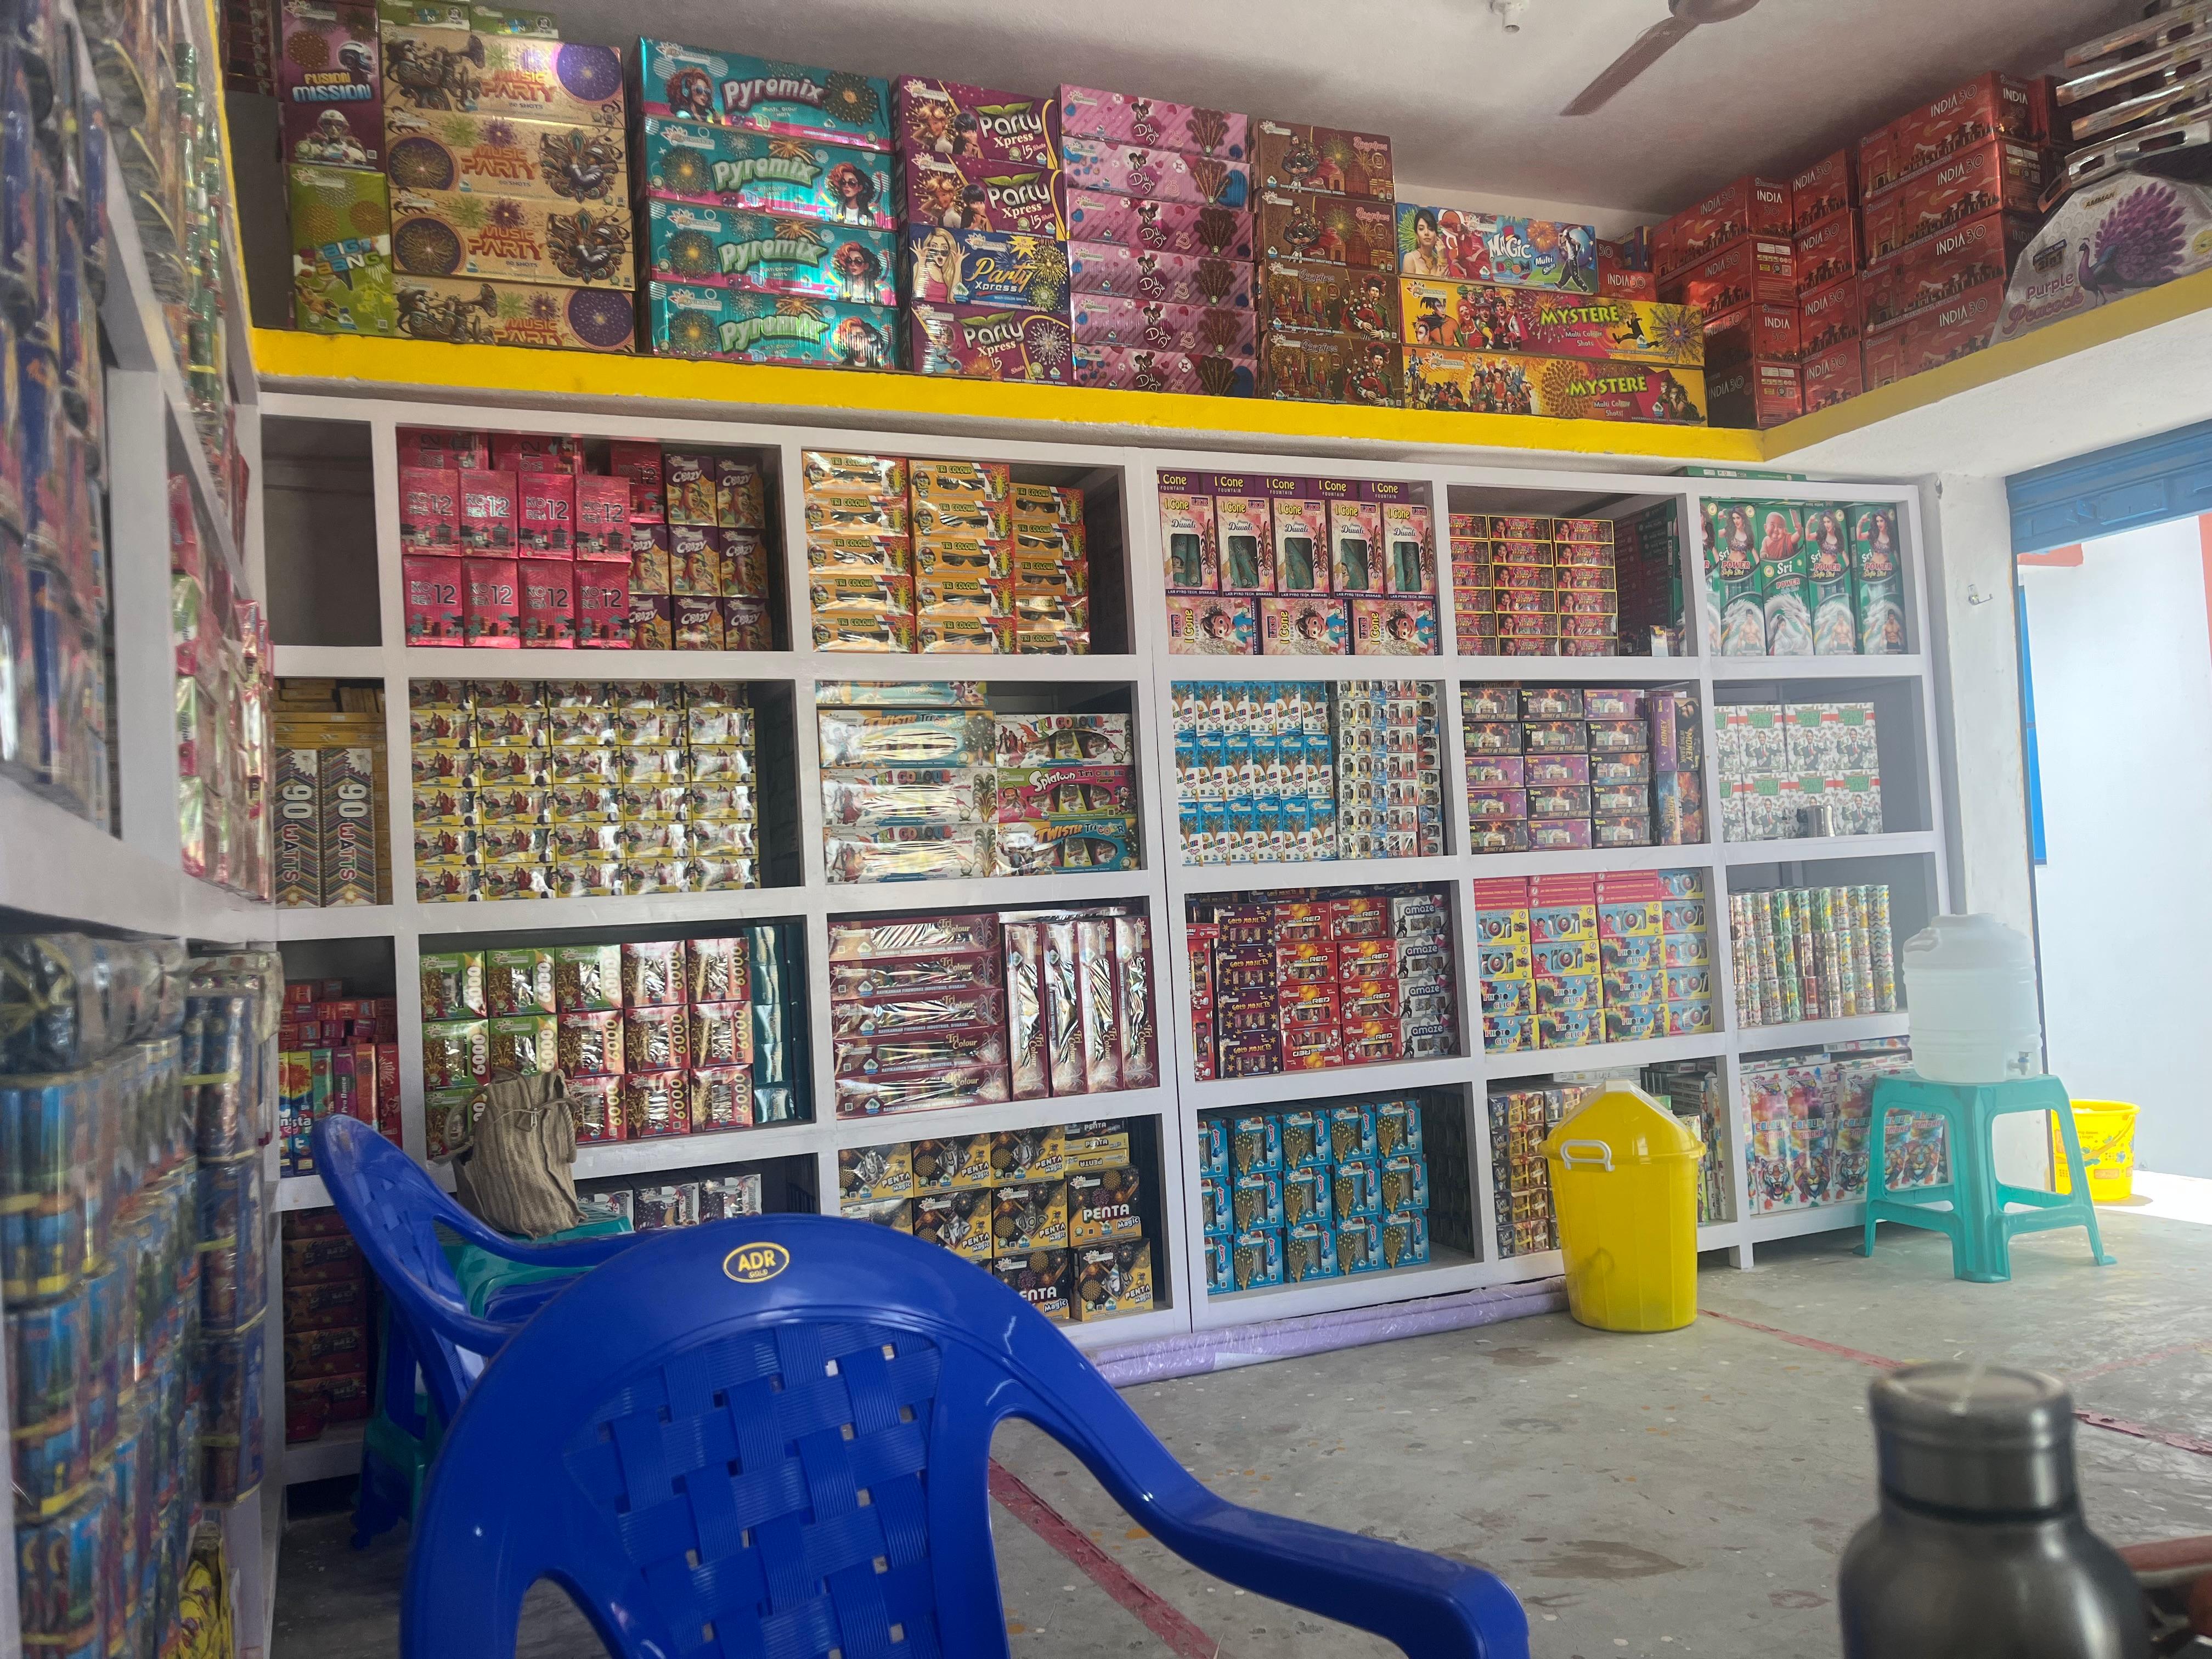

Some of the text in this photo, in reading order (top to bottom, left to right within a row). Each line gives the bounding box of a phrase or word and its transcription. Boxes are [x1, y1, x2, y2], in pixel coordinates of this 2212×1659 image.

[304, 72, 351, 84] FUSION
[292, 84, 371, 102] MISSION
[722, 78, 825, 109] Pyromix
[1931, 84, 1977, 117] INDIA 30
[978, 114, 1042, 138] Party
[1134, 123, 1153, 137] Dil
[994, 133, 1034, 149] Xpress
[473, 145, 527, 159] MUSIC
[1022, 143, 1046, 159] 15 Shots
[461, 156, 540, 179] PARTY
[714, 157, 821, 190] Pyromix
[1130, 172, 1149, 185] Dil
[1793, 170, 1816, 192] INDIA
[1816, 161, 1832, 179] 30
[1142, 180, 1155, 194] Dil
[987, 184, 1051, 210] Party
[1757, 190, 1782, 204] INDIA
[2085, 191, 2115, 208] AMMAN
[1002, 203, 1042, 219] Xpress
[1031, 215, 1041, 229] 15
[481, 225, 535, 240] MUSIC
[1936, 224, 1986, 256] INDIA 30
[468, 236, 546, 260] PARTY
[719, 238, 826, 272] Pyromix
[1536, 255, 1553, 265] Multi
[964, 257, 1037, 293] Party
[1607, 274, 1629, 286] INDIA
[975, 281, 1017, 291] Xpress
[1139, 277, 1159, 290] Dil
[2026, 273, 2075, 301] Purple
[1152, 285, 1165, 299] Dil
[1805, 288, 1845, 317] INDIA 30
[2003, 285, 2085, 335] Peacock
[1540, 305, 1618, 325] MYSTERE
[505, 318, 557, 331] MUSIC
[1765, 317, 1790, 329] INDIA
[494, 329, 569, 346] PARTY
[963, 321, 1024, 348] Party
[977, 341, 1016, 357] Xpress
[991, 357, 1024, 374] 15 Shots
[1831, 354, 1846, 371] 30
[1569, 376, 1647, 397] MYSTERE
[673, 470, 702, 483] CRAZY
[936, 465, 973, 474] TRI COLOUR
[1221, 476, 1244, 488] Cone
[1325, 481, 1347, 492] Cone
[487, 495, 510, 518] 12
[830, 498, 868, 507] TRI COLOUR
[1169, 499, 1189, 510] Cone
[546, 500, 569, 521] 12
[1171, 518, 1196, 528] Diwali
[676, 540, 707, 554] CRAZY
[1778, 562, 1792, 574] Sri
[1776, 578, 1800, 589] POWER
[433, 584, 457, 605] 12
[491, 585, 514, 606] 12
[681, 611, 712, 624] CRAZY
[1184, 608, 1194, 637] Cone
[1198, 708, 1220, 719] COLOUR
[1056, 716, 1104, 729] COLOUR
[1660, 720, 1669, 747] MONEY
[1685, 731, 1694, 762] MONEY
[1029, 770, 1076, 792] Splatoon
[281, 785, 312, 819] 90
[337, 784, 367, 819] 90
[1035, 825, 1082, 842] TWISTER
[282, 824, 299, 882] WATTS
[337, 823, 356, 881] WATTS
[1405, 906, 1434, 914] amaze
[940, 918, 952, 928] Tri
[1410, 985, 1440, 995] amaze
[1483, 994, 1508, 1002] PHOTO
[946, 1034, 959, 1044] Tri
[953, 1040, 978, 1049] Colour
[1915, 1120, 1942, 1129] SMOKE
[1799, 1130, 1825, 1139] SMOKE
[1035, 1156, 1062, 1169] PENTA
[1045, 1164, 1062, 1172] Magic
[1083, 1204, 1130, 1222] PENTA
[1117, 1216, 1140, 1229] Magic
[737, 1249, 776, 1272] ADR
[748, 1268, 768, 1279] GOLD
[1019, 1286, 1057, 1301] ENTA
[1044, 1299, 1068, 1311] Magic
